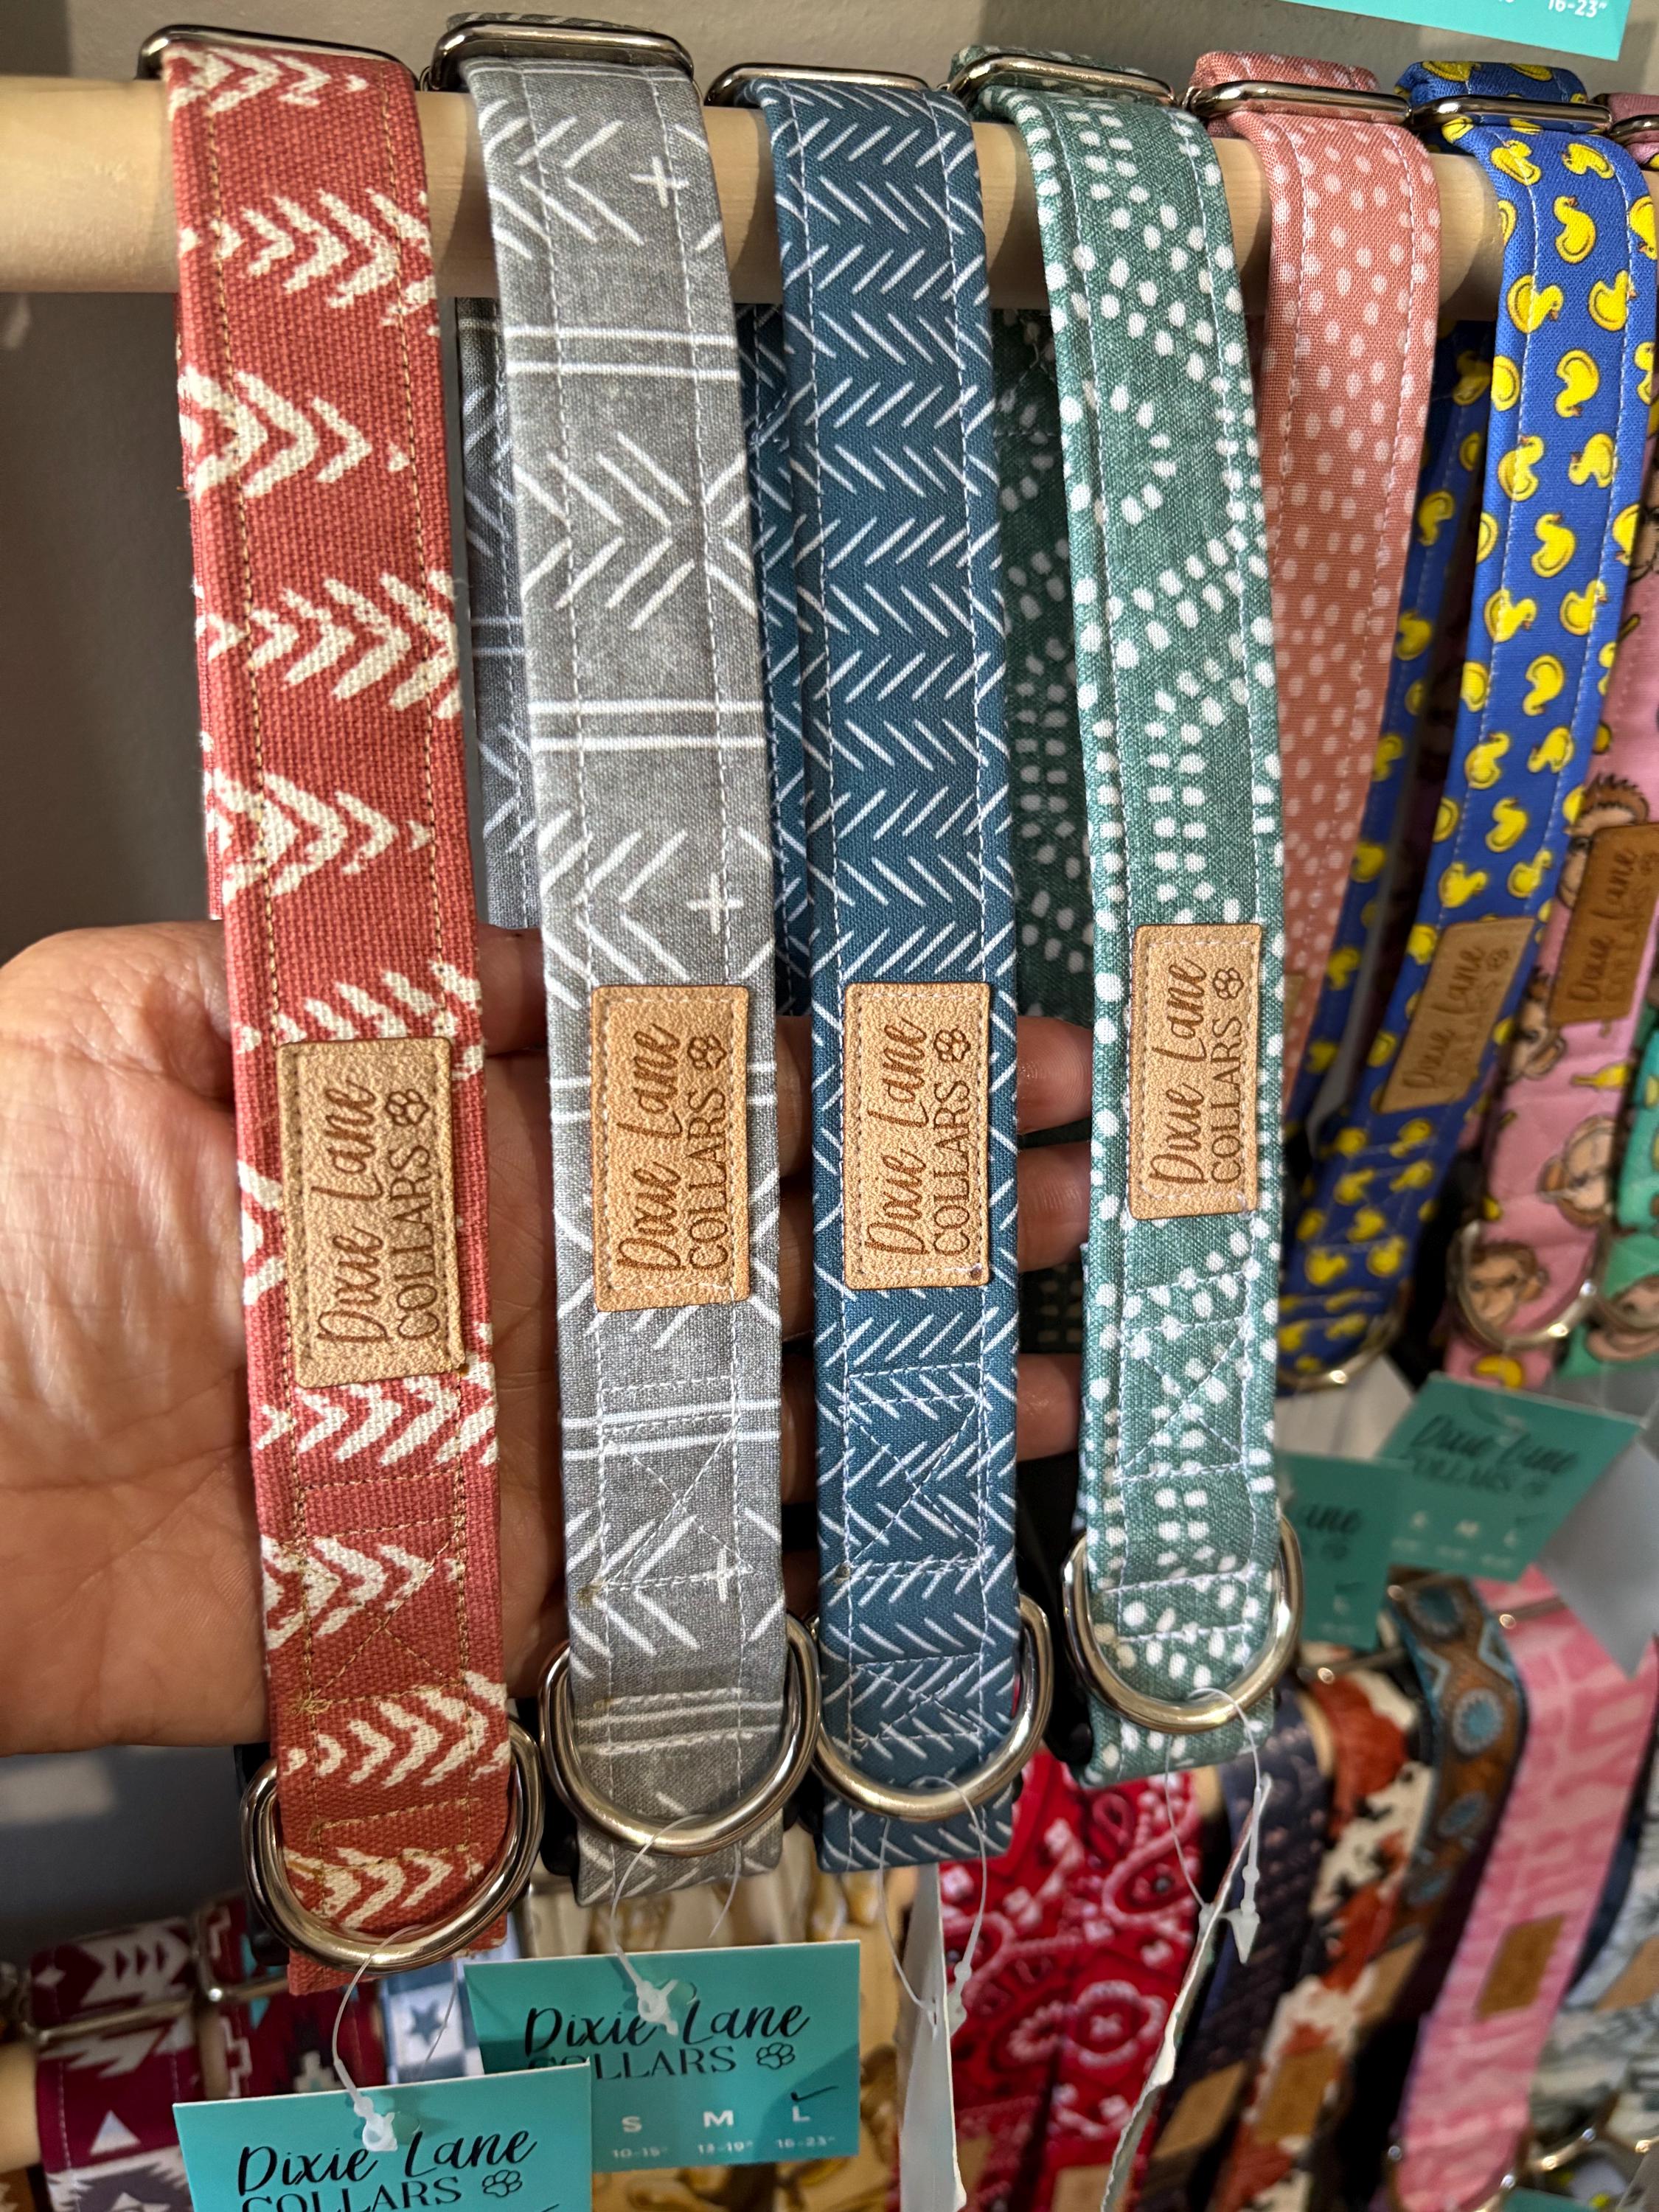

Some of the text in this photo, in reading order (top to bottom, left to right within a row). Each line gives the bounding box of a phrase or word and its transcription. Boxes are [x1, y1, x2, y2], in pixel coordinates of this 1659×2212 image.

[616, 1023, 686, 1270] Dixie Lane
[864, 1018, 929, 1254] Dixie Lane
[1148, 958, 1208, 1185] Dixie Lane
[1210, 1016, 1243, 1184] COLLARS
[311, 1079, 392, 1343] Dixie Lane
[389, 1145, 440, 1340] COLLARS
[687, 1087, 728, 1270] COLLARS
[933, 1080, 970, 1255] COLLARS
[525, 1999, 810, 2058] Dixie Lane
[527, 2046, 738, 2080] LLARS
[237, 2130, 538, 2197] Dixie Lane
[622, 2105, 810, 2133] S M L
